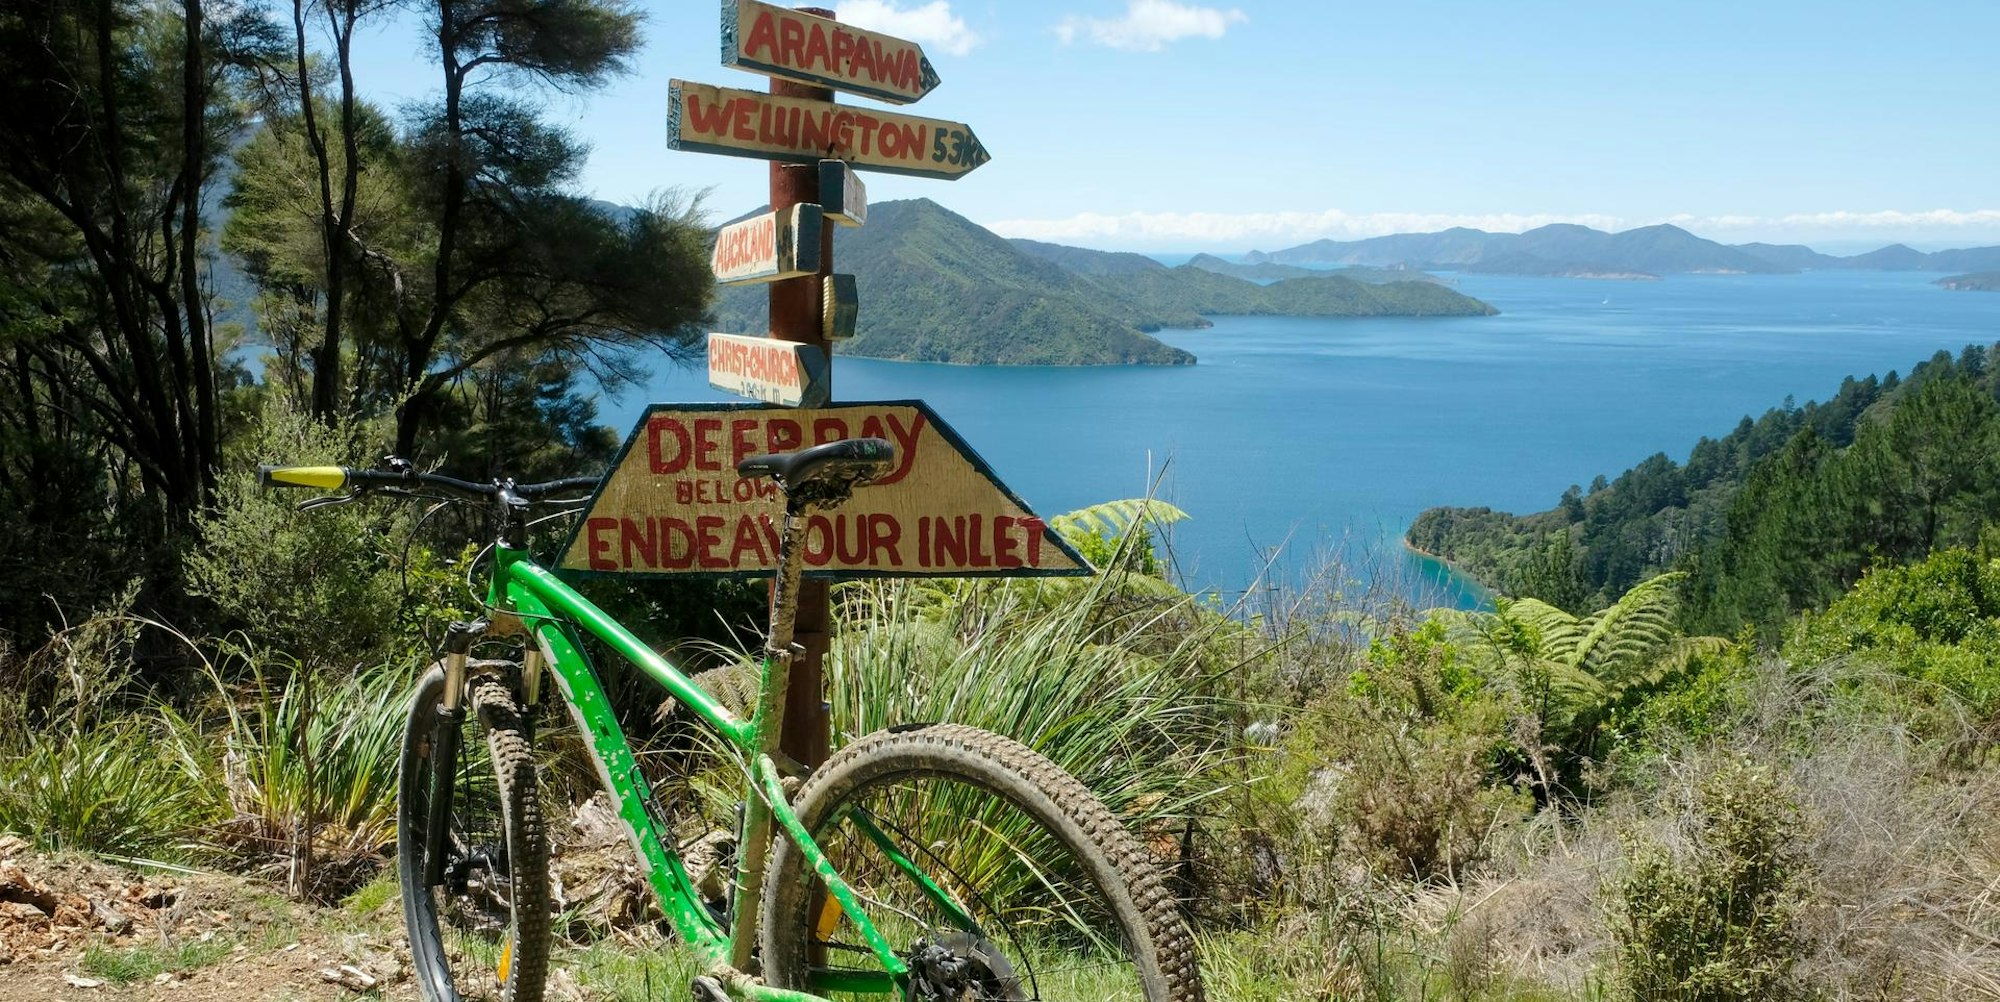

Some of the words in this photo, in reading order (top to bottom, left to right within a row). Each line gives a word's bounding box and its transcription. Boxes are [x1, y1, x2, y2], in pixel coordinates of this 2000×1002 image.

[745, 11, 919, 93] ARAPAWA
[688, 95, 927, 161] WELLINGTON
[714, 219, 775, 274] AUCKLAND
[709, 338, 799, 387] CHRIST-CHURCH
[648, 417, 803, 474] DEEP
[676, 477, 778, 506] BELOW
[918, 515, 1047, 568] INLET
